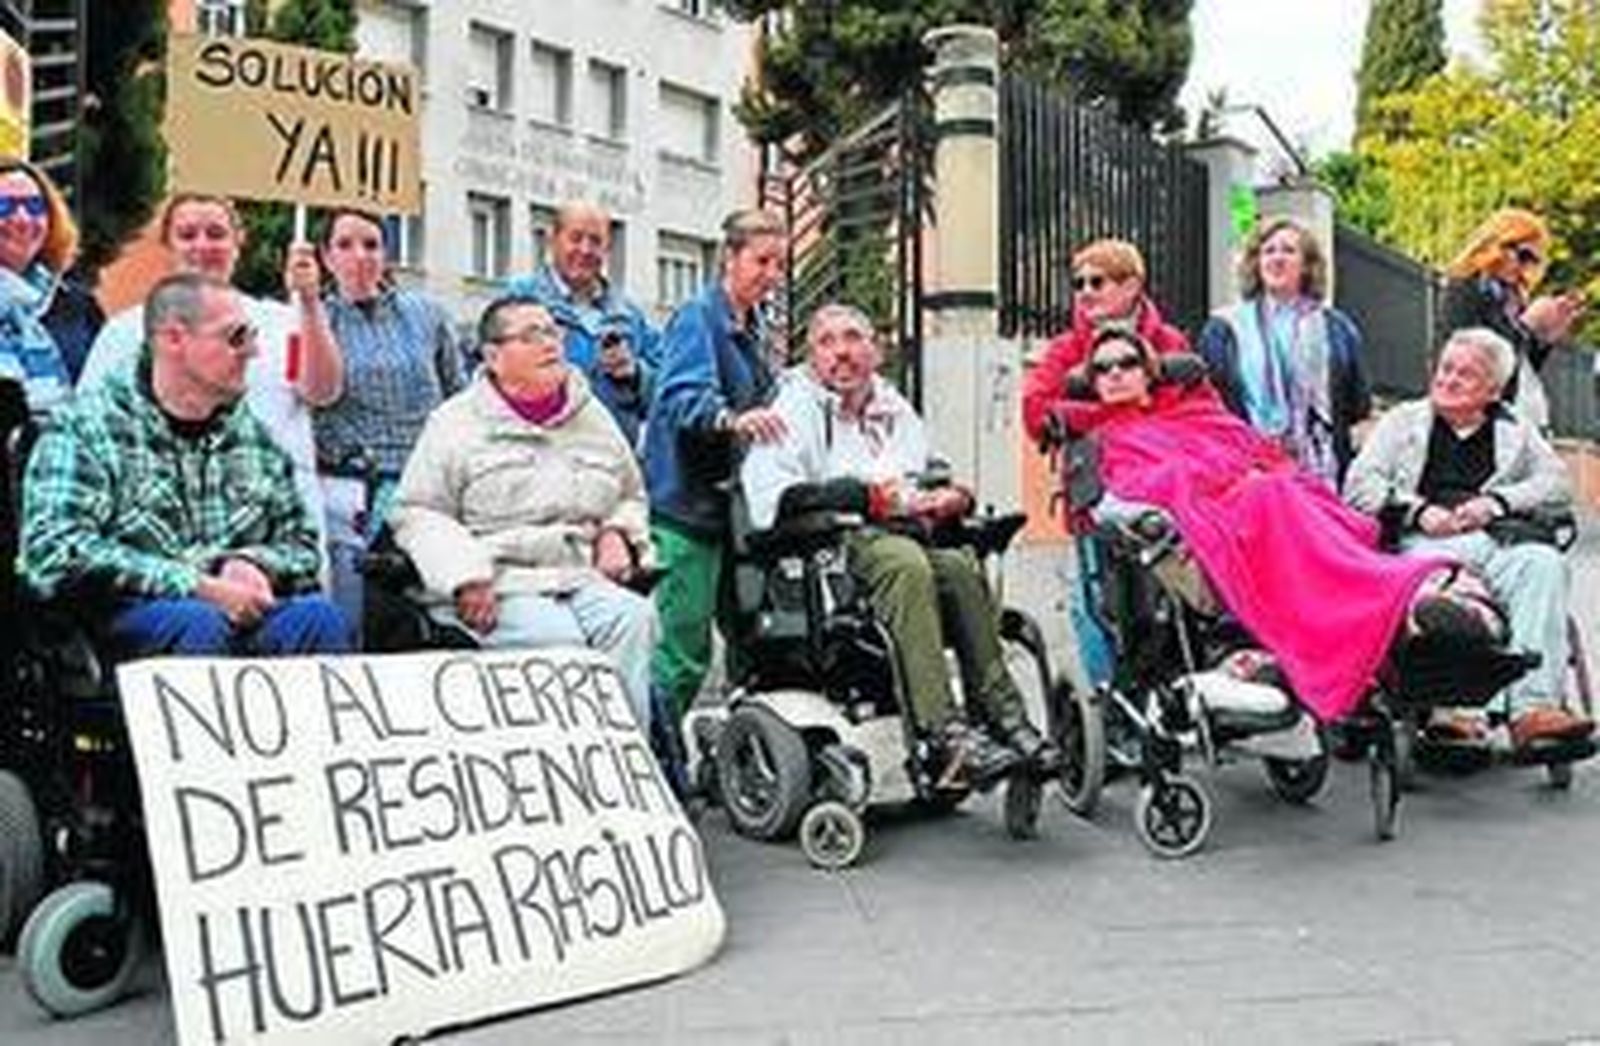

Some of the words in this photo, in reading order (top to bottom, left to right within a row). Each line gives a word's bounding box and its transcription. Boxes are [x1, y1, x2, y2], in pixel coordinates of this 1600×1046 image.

[152, 664, 289, 762] NO
[319, 663, 429, 745] AL
[433, 657, 637, 733] CIERRE
[174, 775, 305, 884] DE
[199, 866, 501, 1044] HUERTA
